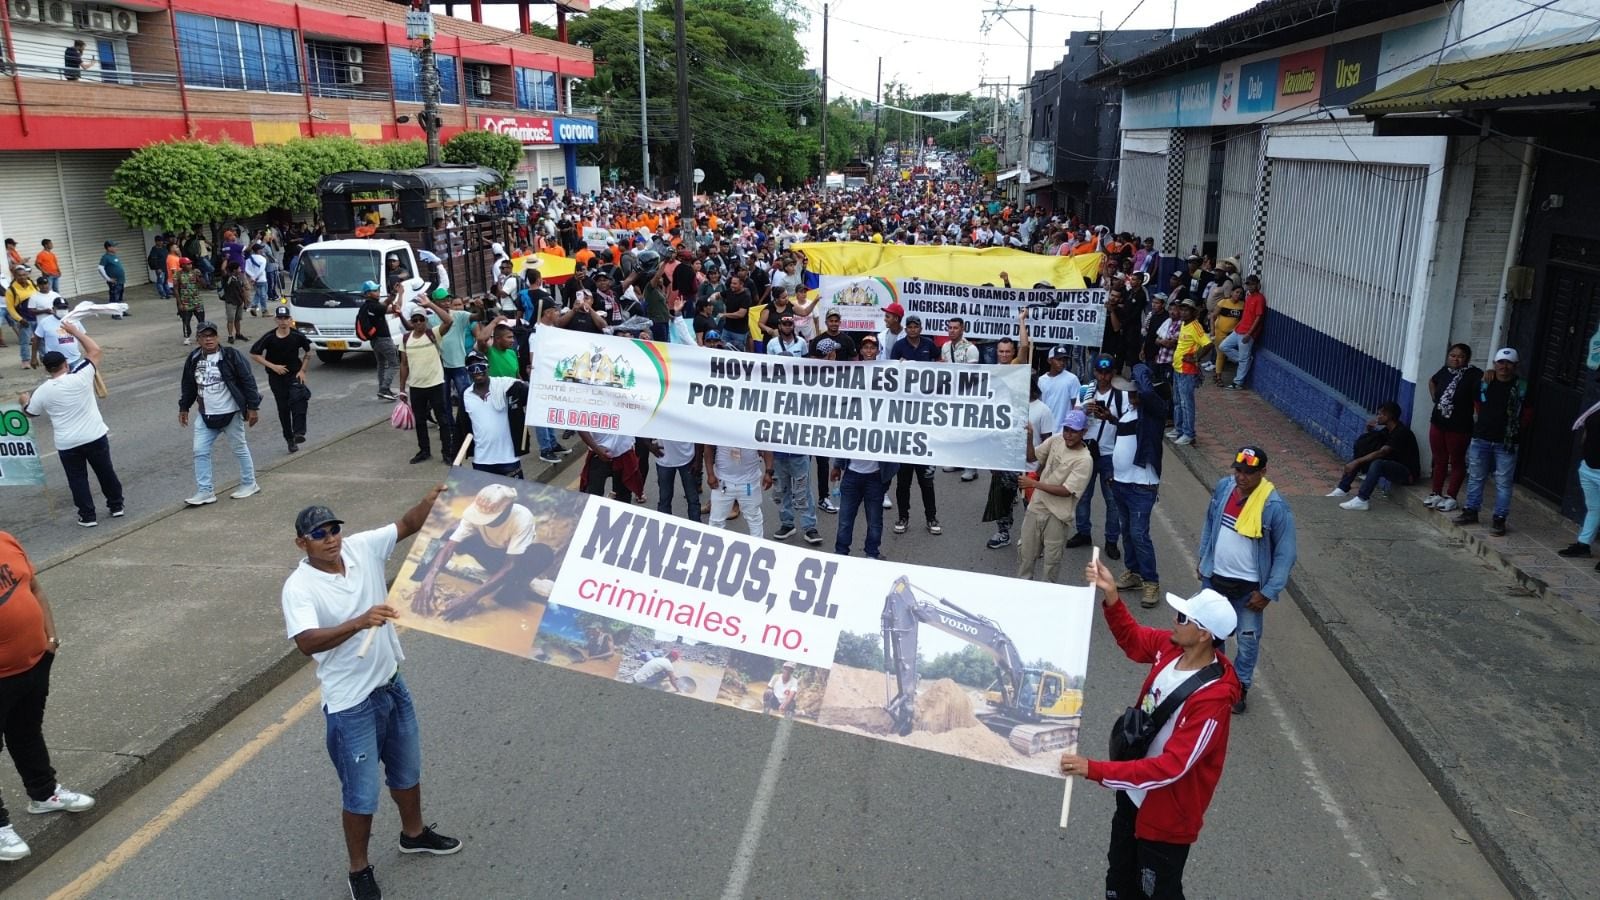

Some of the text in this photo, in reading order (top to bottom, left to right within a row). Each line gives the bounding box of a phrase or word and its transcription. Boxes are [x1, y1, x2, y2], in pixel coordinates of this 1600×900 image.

[1247, 75, 1263, 100] Delo
[1282, 68, 1316, 96] Havoline
[1336, 60, 1361, 89] Ursa
[560, 124, 594, 140] corona
[903, 281, 1107, 305] LOS MINEROS ORAMOS A DIOS ANTES DE
[908, 299, 959, 315] INGRESAR
[959, 303, 968, 315] A
[969, 303, 982, 317] LA
[1032, 307, 1040, 321] Q
[1041, 308, 1075, 322] PUEDE
[1077, 309, 1098, 323] SER
[925, 319, 972, 334] NUESO
[973, 319, 1011, 336] ÚLTIMO
[1012, 323, 1031, 338] DA
[1033, 325, 1047, 339] DE
[710, 356, 993, 399] HOY LA LUCHA ES POR MI,
[687, 381, 1012, 430] POR MI FAMILIA Y NUESTRAS
[547, 408, 620, 430] EL BAGRE
[754, 418, 933, 457] GENERACIONES.
[580, 505, 839, 620] MINEROS, SI.
[578, 577, 809, 653] criminales, no.
[939, 614, 979, 636] VOLVO
